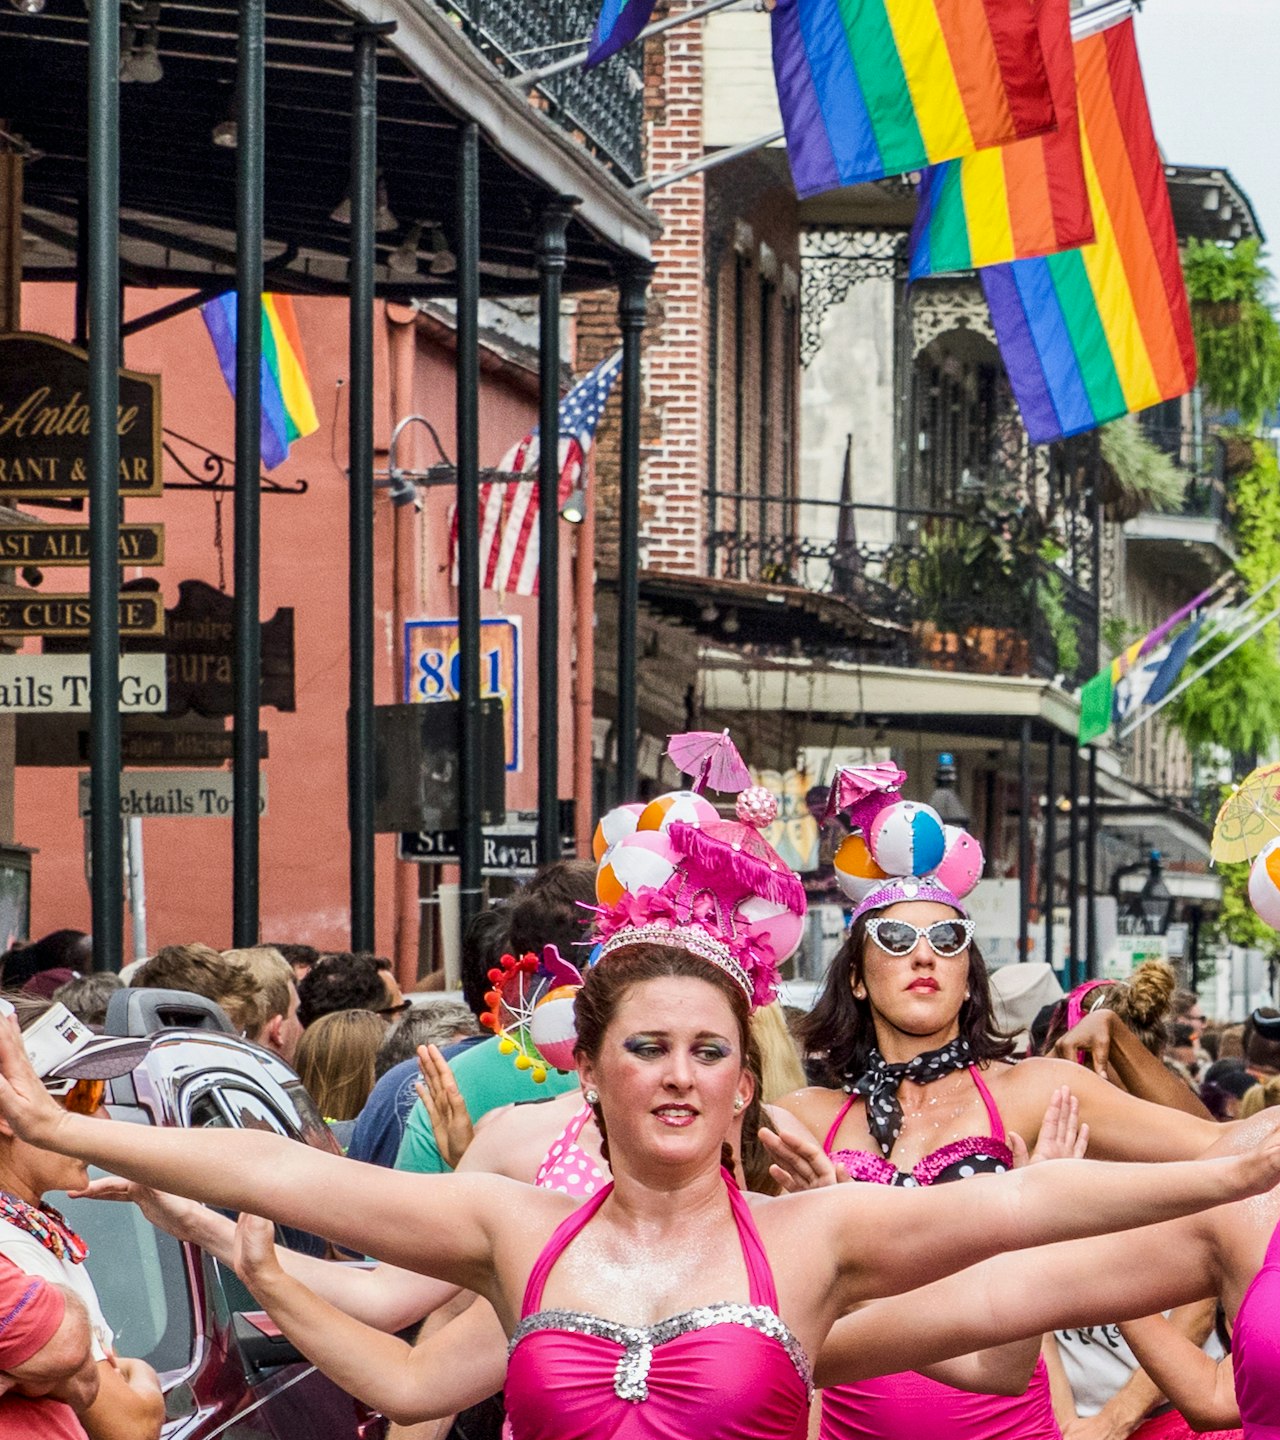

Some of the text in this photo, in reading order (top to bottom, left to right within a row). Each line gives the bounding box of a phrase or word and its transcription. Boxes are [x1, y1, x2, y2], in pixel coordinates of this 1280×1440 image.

[70, 457, 86, 481] &
[113, 457, 148, 481] AR
[44, 535, 88, 556] ALL
[112, 535, 143, 556] AY
[23, 603, 143, 626] CUISE
[62, 676, 95, 707] T
[119, 675, 161, 706] Go
[106, 788, 194, 815] cktails
[417, 831, 455, 852] St.
[482, 838, 537, 869] Royal
